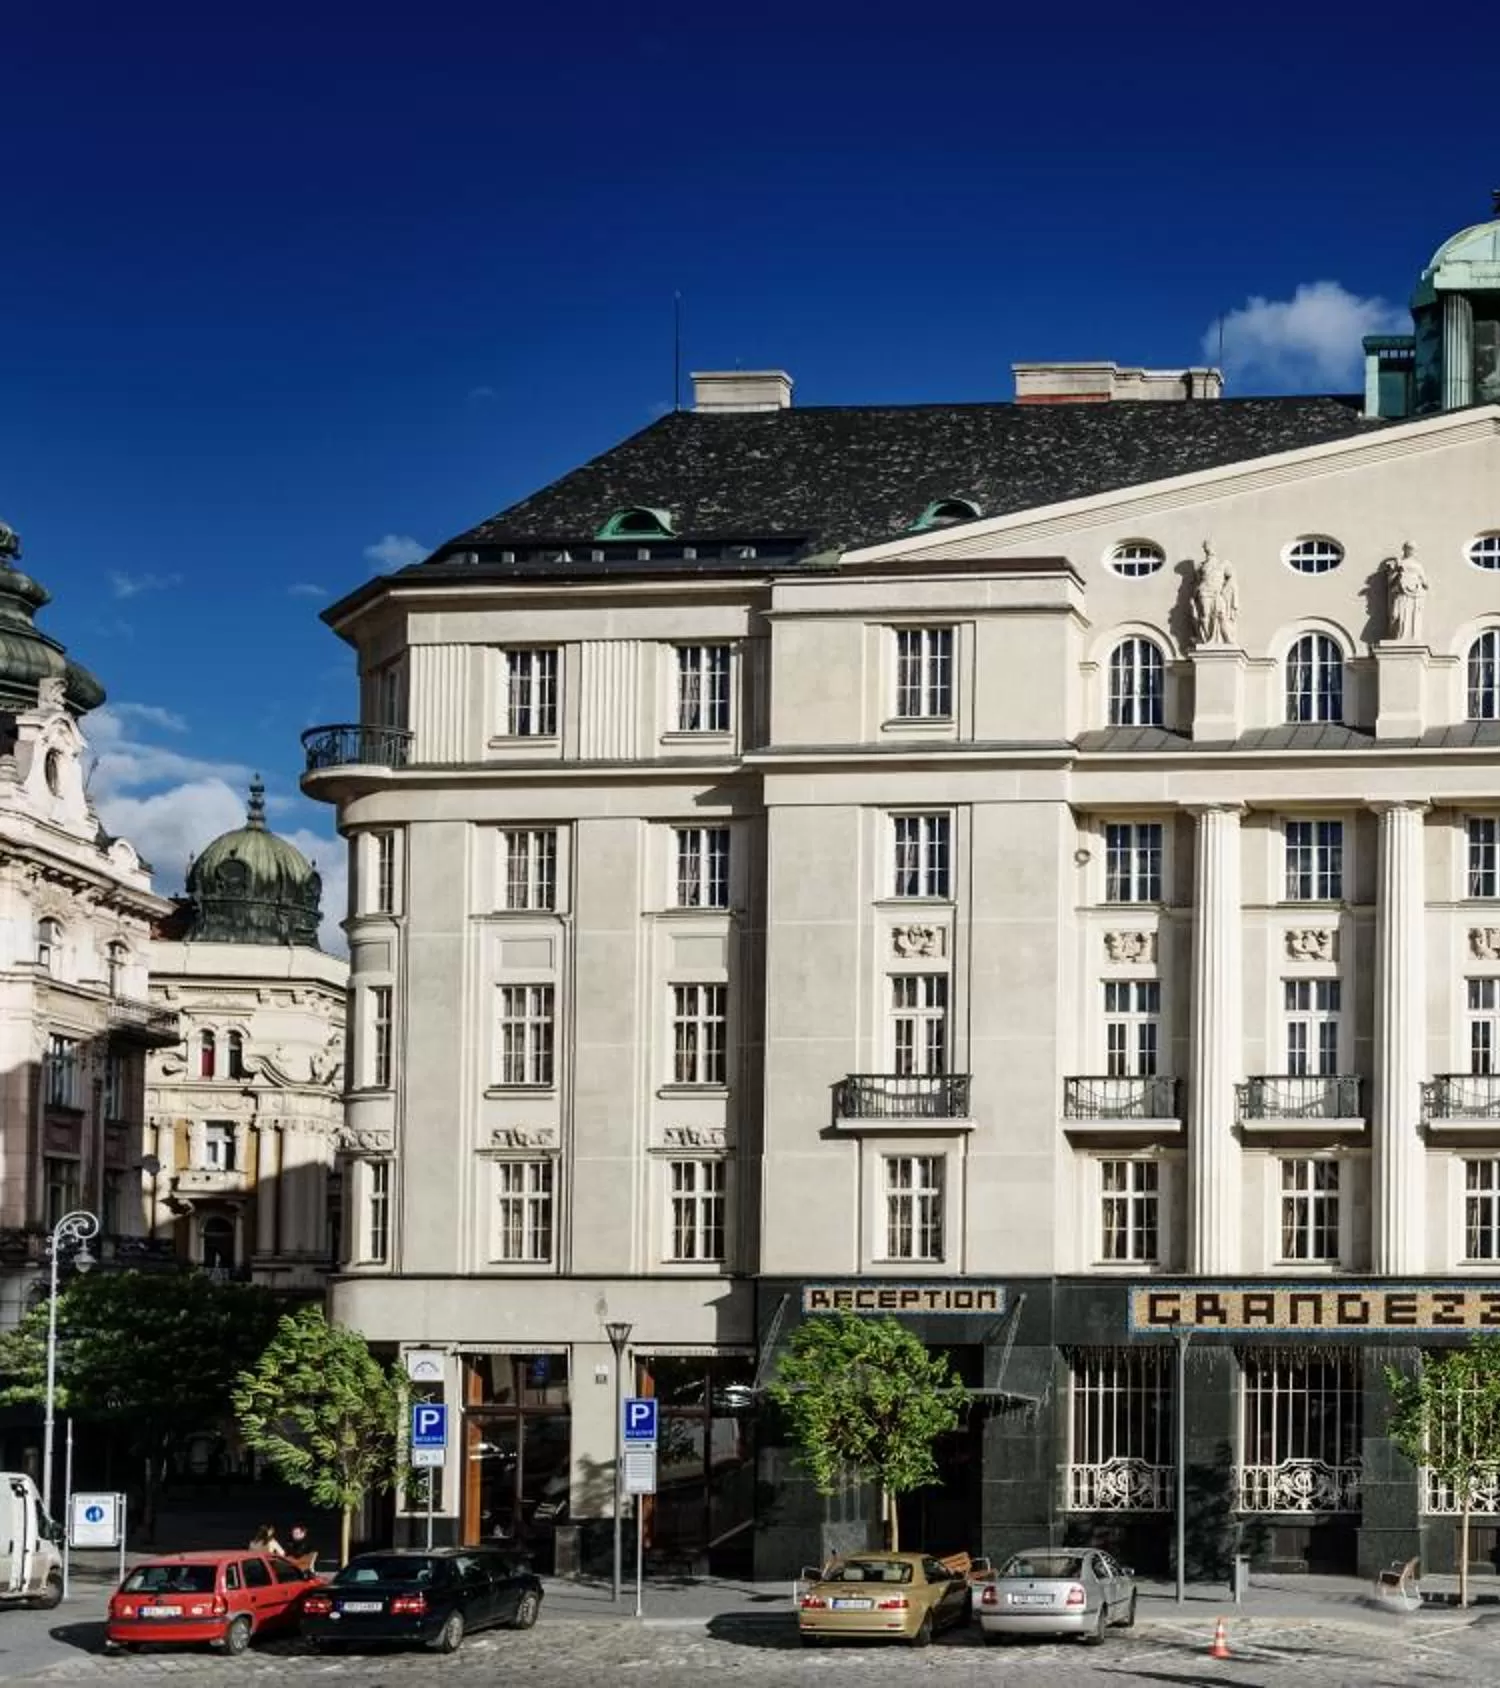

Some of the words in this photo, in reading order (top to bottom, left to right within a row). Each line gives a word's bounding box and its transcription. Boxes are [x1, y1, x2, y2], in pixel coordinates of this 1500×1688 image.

[811, 1290, 996, 1309] RECEPTION
[420, 1409, 440, 1434] P
[631, 1403, 650, 1428] P
